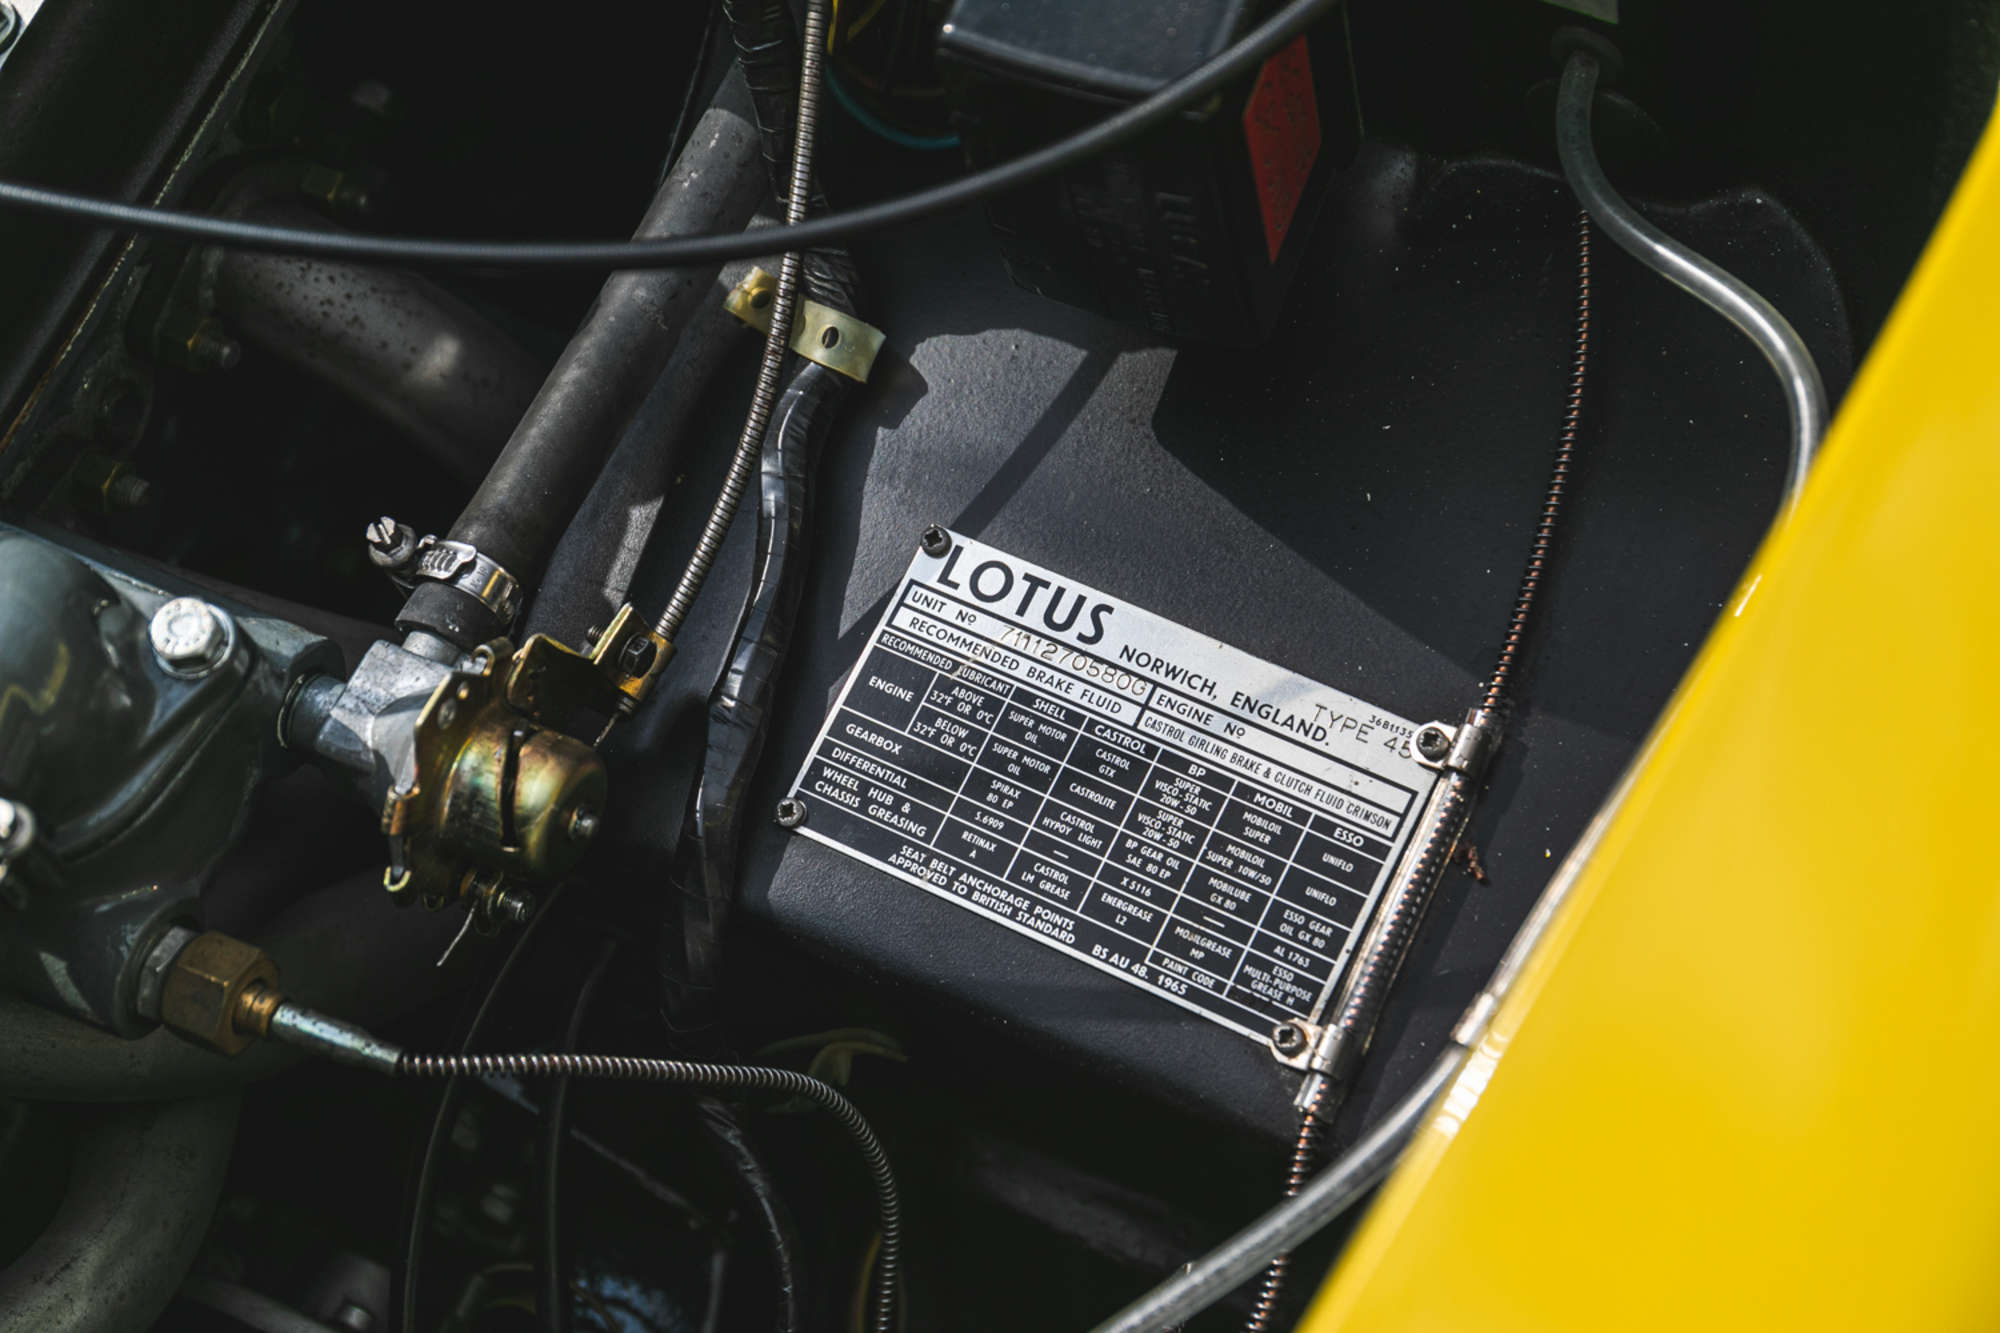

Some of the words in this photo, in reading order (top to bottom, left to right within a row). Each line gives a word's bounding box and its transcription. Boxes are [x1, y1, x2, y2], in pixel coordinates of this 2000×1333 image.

[911, 590, 947, 613] UNIT
[936, 544, 1115, 645] LOTUS
[880, 632, 953, 670] RECOMMENDED
[956, 664, 1011, 697] LUBRICANT
[908, 616, 1020, 671] RECOMMENDED
[1025, 665, 1075, 694] BRAKE
[1079, 688, 1122, 714] FLUID
[868, 675, 914, 702] ENGINE
[950, 686, 985, 707] ABOVE
[1118, 644, 1217, 700] NORWICH,
[1229, 690, 1329, 746] ENGLAND.
[956, 701, 972, 715] OR
[1032, 698, 1066, 720] SHELL
[1156, 693, 1214, 726] ENGINE
[934, 716, 969, 738] BELOW
[1008, 710, 1035, 728] SUPER
[1037, 723, 1067, 742] MOTOR
[1307, 702, 1376, 744] TYPE
[845, 723, 902, 755] GEARBOX
[939, 733, 955, 747] OR
[1024, 731, 1038, 744] OIL
[1094, 724, 1146, 754] CASTROL
[831, 746, 907, 789] DIFFERENTIAL
[991, 742, 1019, 760] SUPER
[1021, 755, 1051, 774] MOTOR
[1007, 762, 1021, 776] OIL
[1095, 748, 1130, 770] CASTROL
[1187, 763, 1206, 777] BP
[1098, 764, 1116, 778] GTX
[1143, 716, 1185, 743] CASTROL
[1187, 734, 1229, 760] GIRLING
[1229, 751, 1262, 775] BRAKE
[1262, 767, 1271, 779] &
[1273, 770, 1313, 796] CLUTCH
[1313, 788, 1345, 810] FLUID
[1345, 802, 1392, 830] CRIMSON
[822, 766, 859, 791] WHEEL
[867, 786, 894, 806] HUB
[900, 801, 911, 814] &
[990, 779, 1021, 799] SPIRAX
[1069, 782, 1117, 810] CASTROLITE
[1173, 777, 1201, 795] SUPER
[814, 780, 861, 808] CHASSIS
[867, 804, 927, 837] GREASING
[985, 792, 999, 804] 80
[1001, 798, 1014, 809] EP
[1253, 792, 1293, 818] MOBIL
[1059, 811, 1095, 834] CASTROL
[1156, 809, 1184, 828] SUPER
[1242, 811, 1282, 835] MOBILOIL
[961, 830, 997, 852] RETINAX
[1041, 816, 1073, 835] HYPOY
[1077, 832, 1103, 849] LIGHT
[1243, 826, 1271, 845] SUPER
[1333, 827, 1364, 847] ESSO
[968, 849, 976, 858] A
[1124, 838, 1138, 849] BP
[1140, 845, 1164, 862] GEAR
[1165, 856, 1180, 870] OIL
[1225, 843, 1265, 868] MOBILOIL
[1321, 852, 1354, 872] UNIFLO
[1033, 862, 1069, 885] CASTROL
[1125, 853, 1143, 868] SAE
[1145, 862, 1159, 874] 80
[1158, 868, 1171, 879] EP
[1205, 850, 1234, 869] SUPER
[1237, 864, 1272, 886] 10W/50
[899, 844, 927, 863] SEAT
[928, 858, 957, 876] BELT
[958, 872, 1031, 911] ANCHORAGE
[1033, 905, 1075, 931] POINTS
[1020, 871, 1035, 883] LM
[1038, 879, 1071, 900] GREASE
[1120, 876, 1129, 886] X
[1207, 876, 1252, 903] MOBILUBE
[1100, 892, 1153, 922] ENERGREASE
[1209, 892, 1224, 905] GX
[1223, 898, 1237, 910] 80
[1304, 886, 1337, 906] UNIFLO
[887, 853, 948, 886] APPROVED
[951, 880, 968, 895] TO
[971, 890, 1013, 916] BRITISH
[1015, 910, 1075, 944] STANDARD
[1091, 943, 1109, 959] BS
[1108, 952, 1130, 969] AU
[1157, 974, 1188, 995] 1965
[1114, 913, 1127, 926] L2
[1283, 908, 1305, 925] ESSO
[1308, 920, 1333, 937] GEAR
[1279, 922, 1294, 936] OIL
[1297, 930, 1312, 942] GX
[1311, 936, 1326, 949] 80
[1189, 947, 1205, 960] MP
[1273, 945, 1285, 957] AL
[1287, 951, 1310, 968] 1763
[1161, 957, 1189, 975] PAINT
[1191, 971, 1215, 988] CODE
[1242, 964, 1312, 1002] MULTI-PURPOSE
[1271, 965, 1294, 982] ESSO
[1250, 979, 1284, 1001] GREASE
